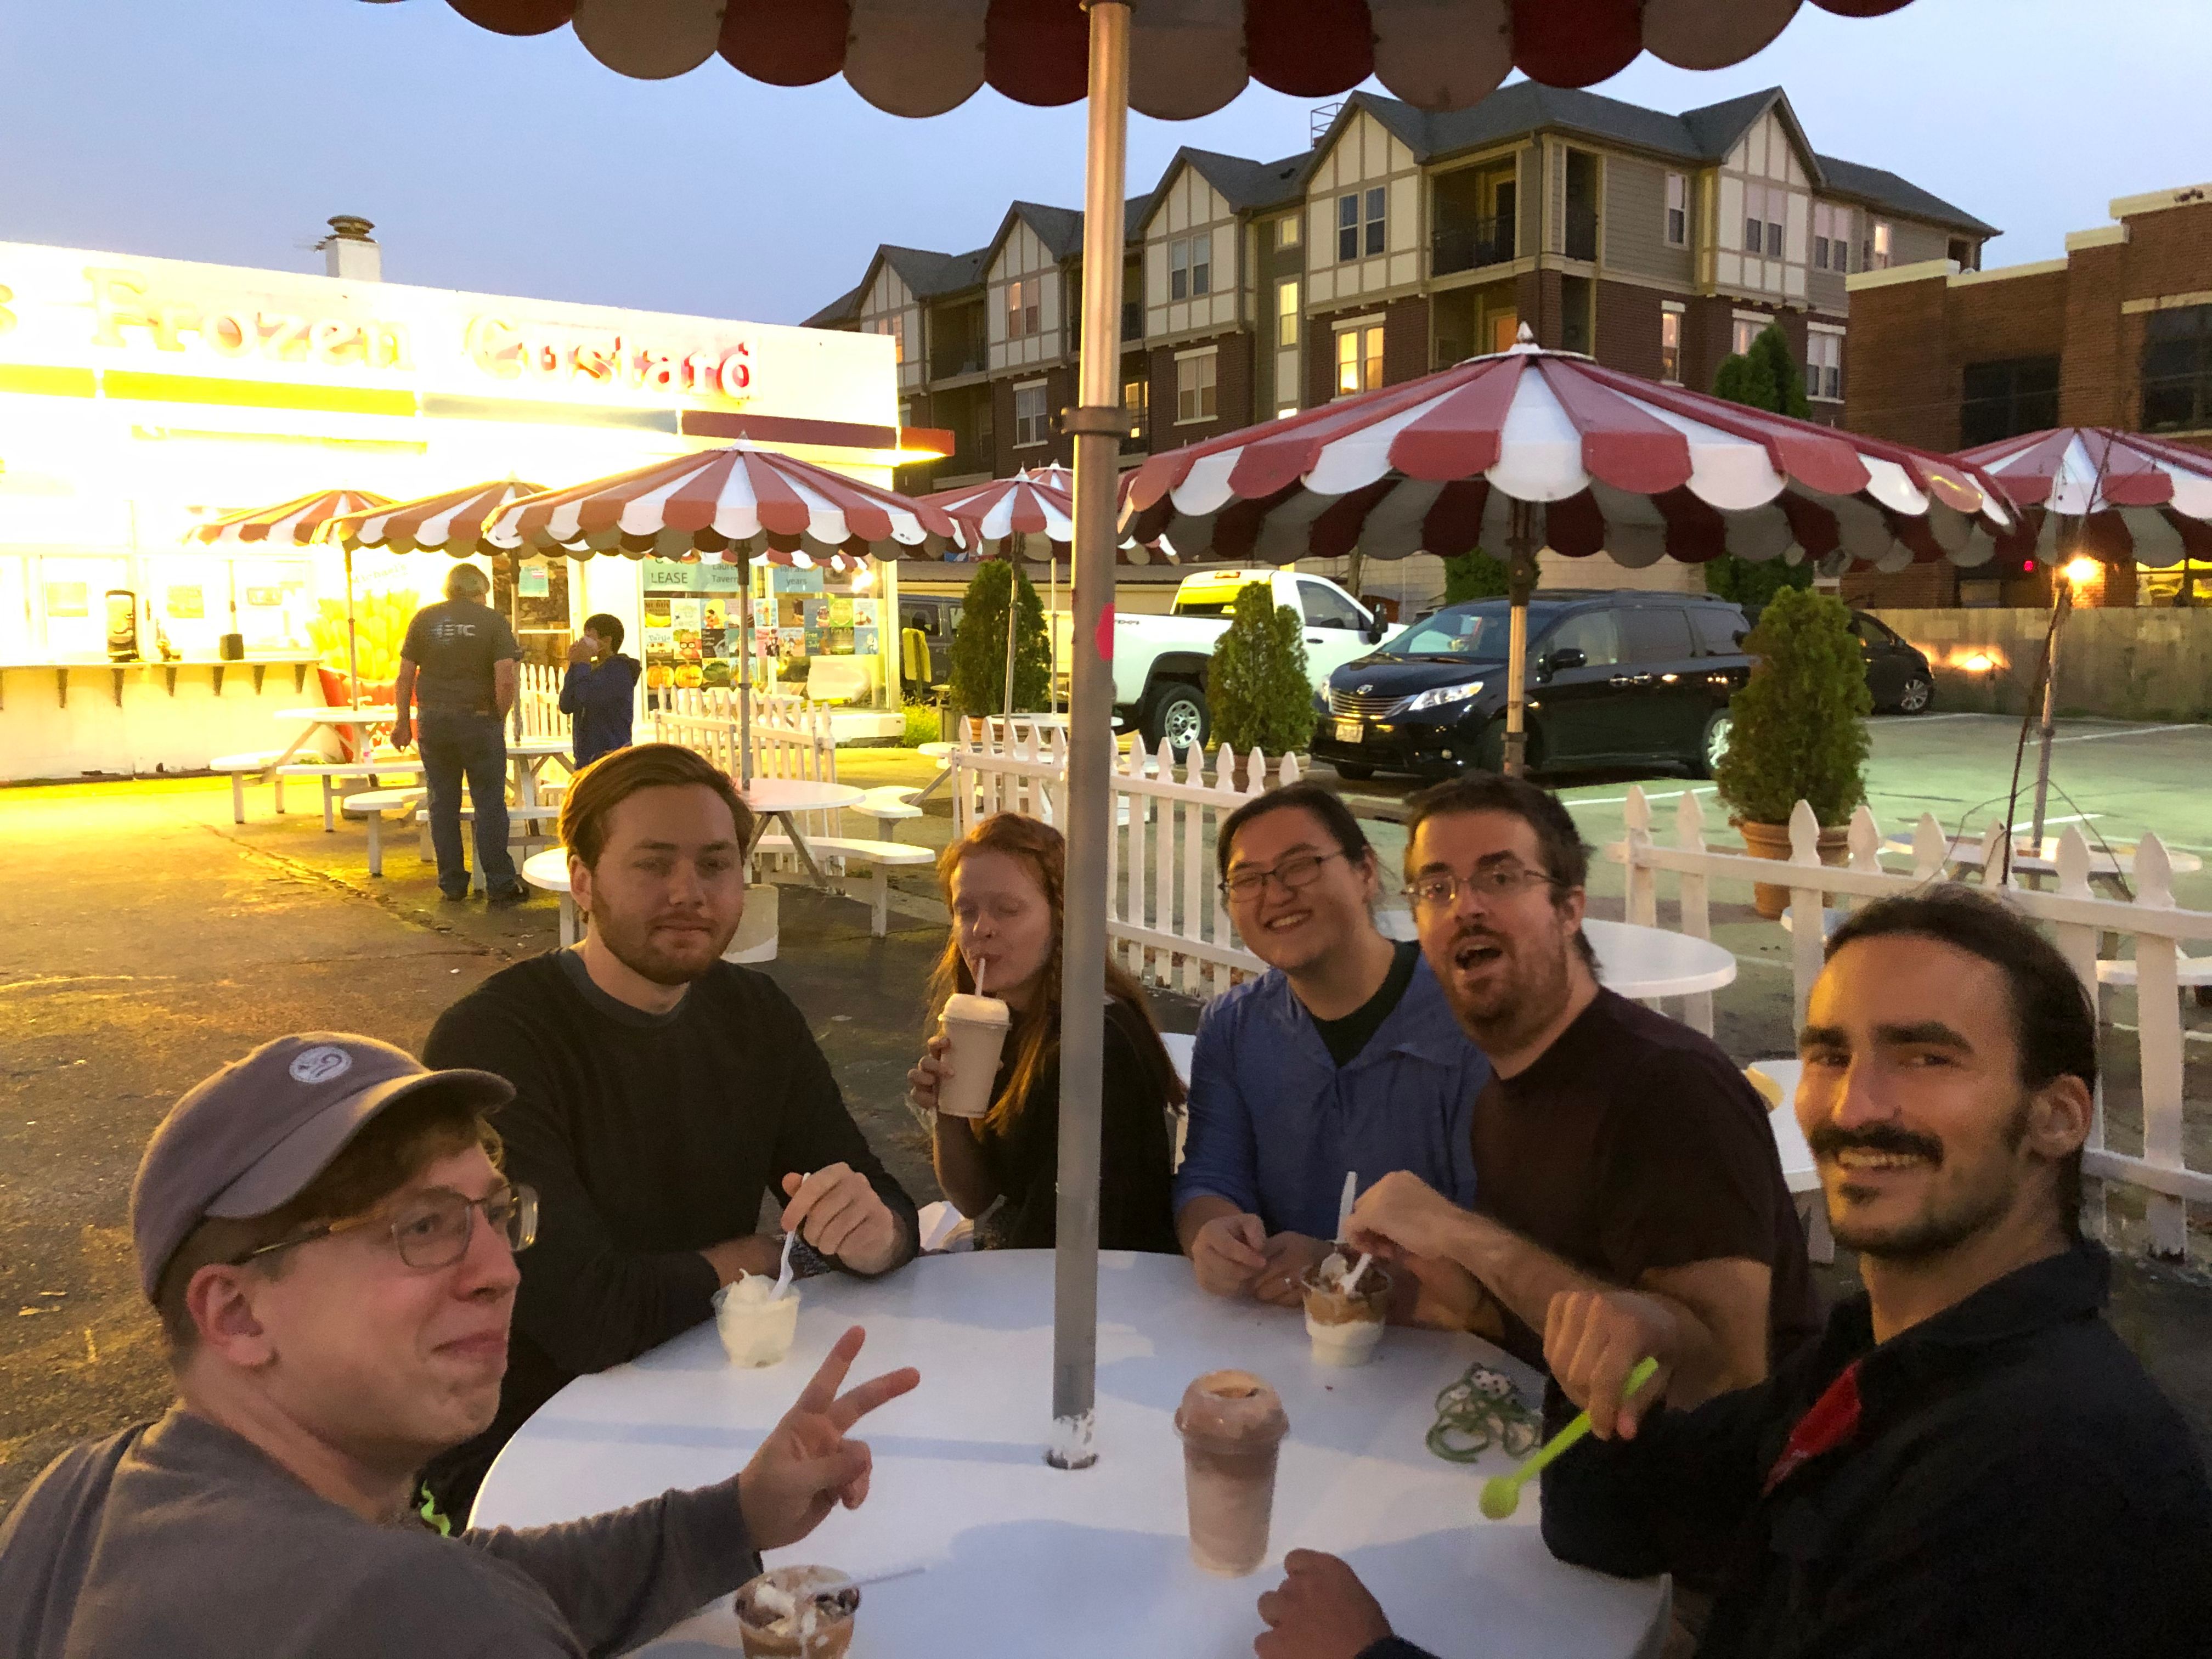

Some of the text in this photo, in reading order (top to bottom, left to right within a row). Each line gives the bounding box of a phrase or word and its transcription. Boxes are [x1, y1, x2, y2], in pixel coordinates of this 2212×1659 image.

[82, 266, 416, 371] Frozen
[465, 313, 759, 399] Custard
[651, 572, 688, 584] LEASE
[786, 578, 808, 586] years
